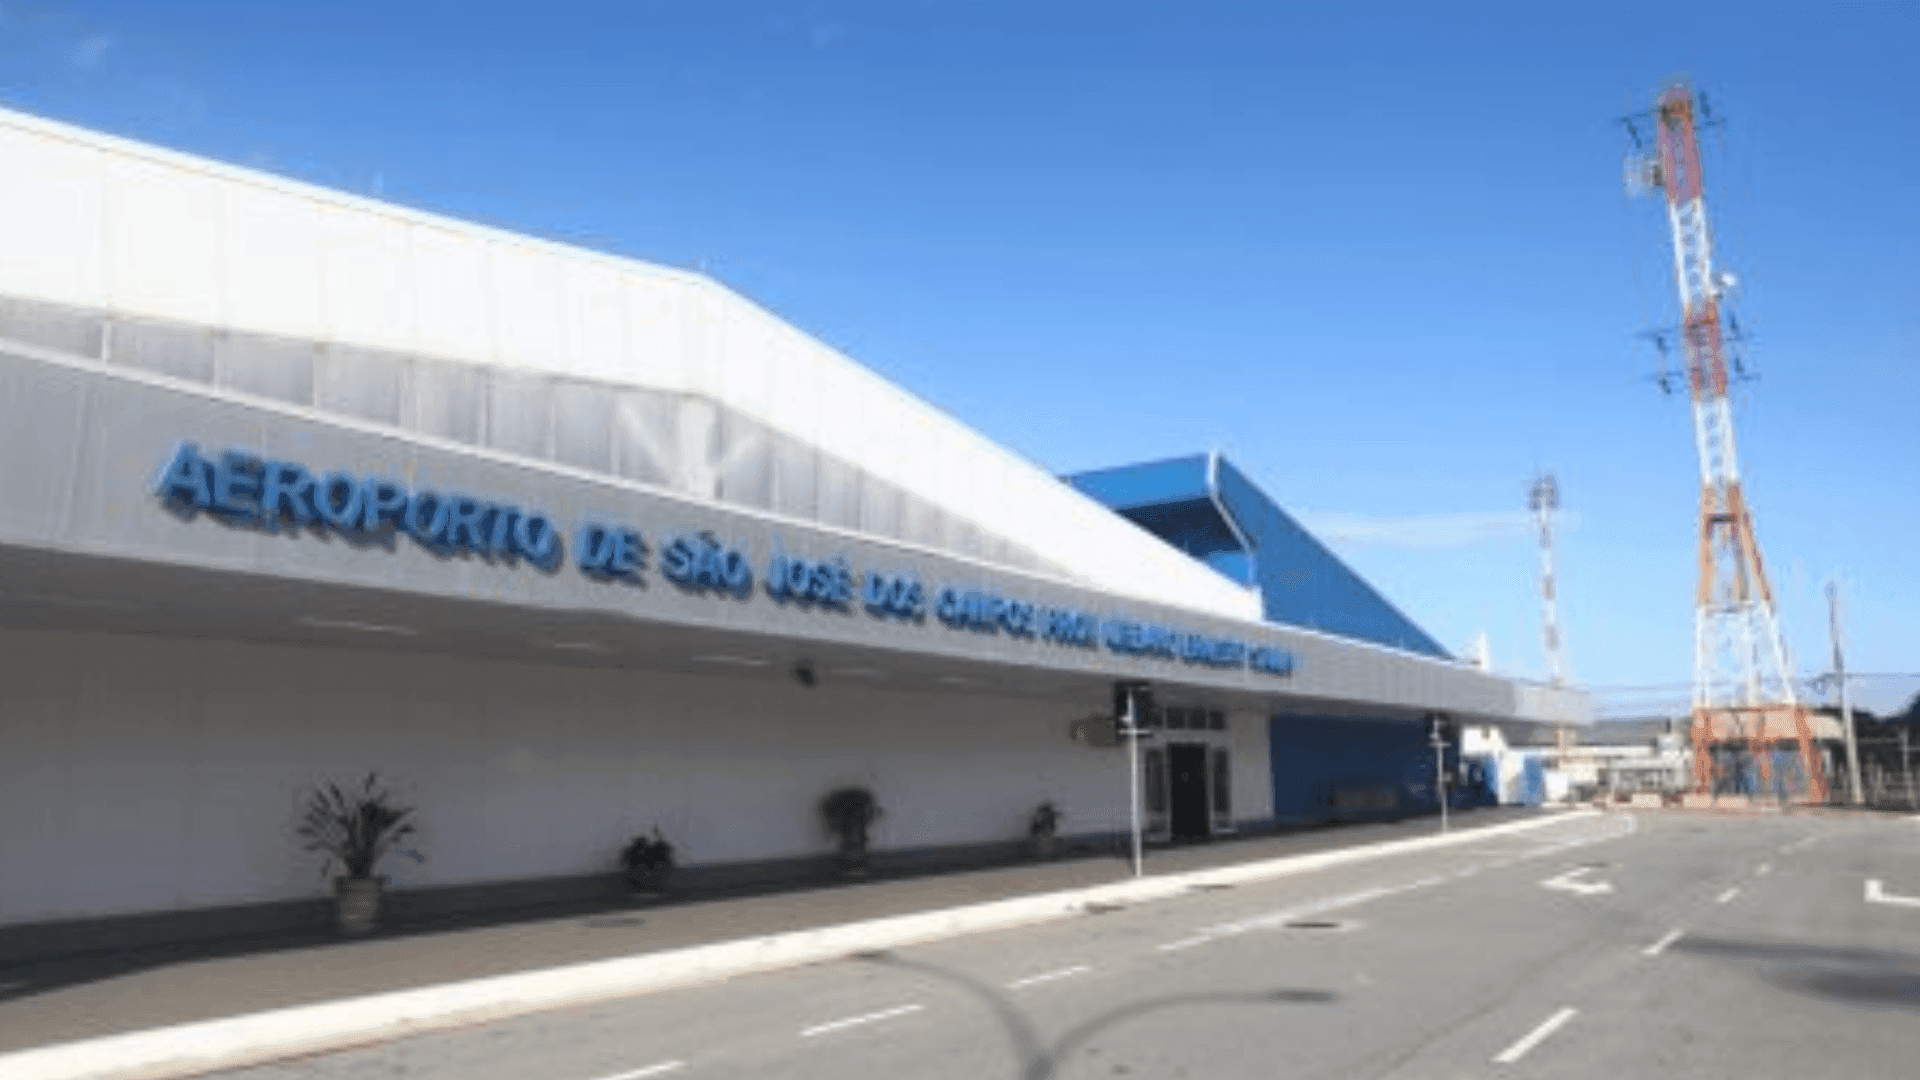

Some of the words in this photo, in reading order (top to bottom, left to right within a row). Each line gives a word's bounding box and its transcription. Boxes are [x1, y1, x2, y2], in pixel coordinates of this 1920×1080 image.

[154, 441, 563, 568] AEROPORTO
[574, 523, 648, 583] DE
[661, 529, 753, 596] SÃO
[863, 571, 925, 618] DOS
